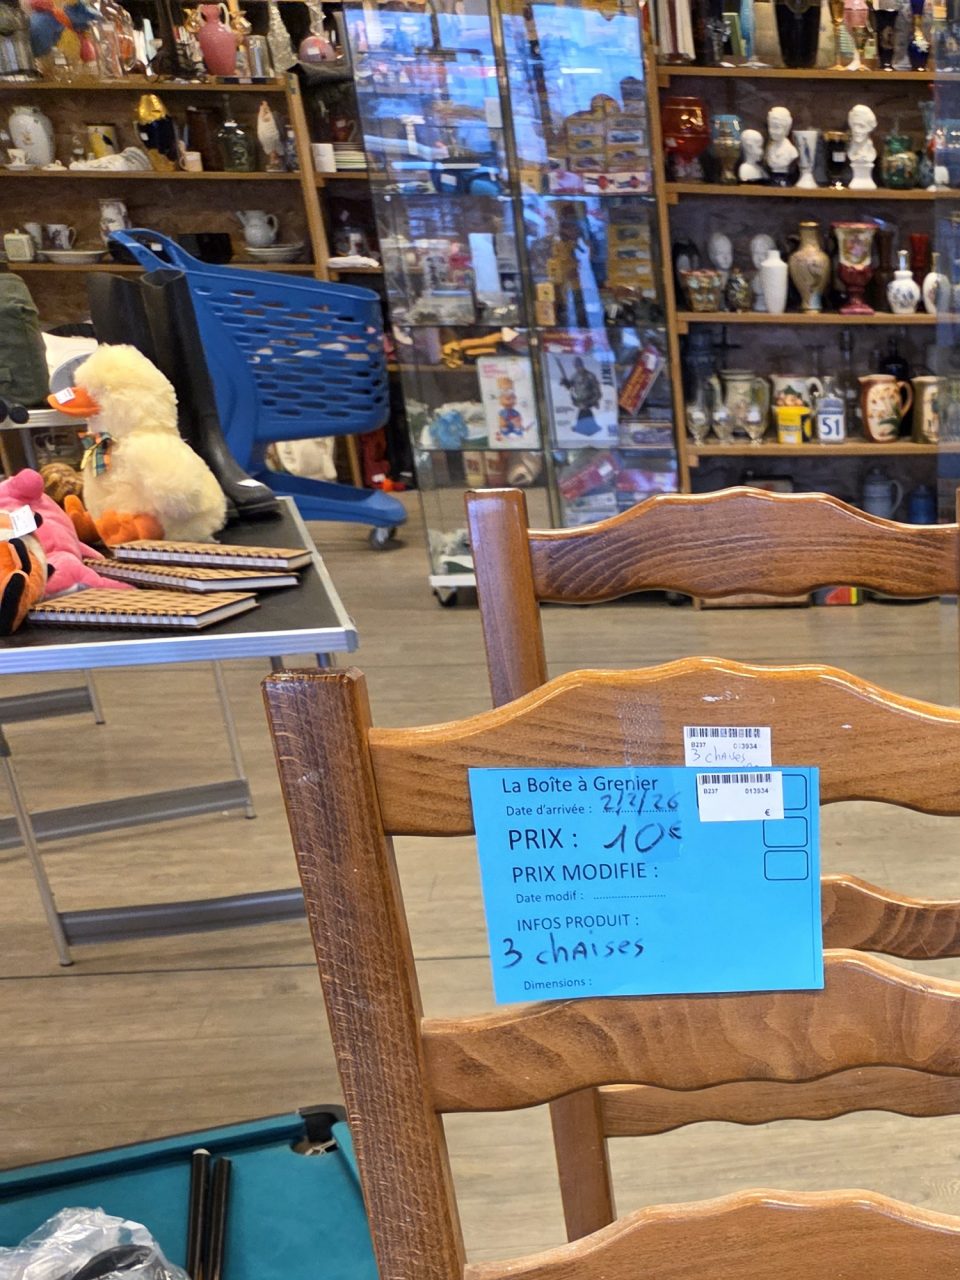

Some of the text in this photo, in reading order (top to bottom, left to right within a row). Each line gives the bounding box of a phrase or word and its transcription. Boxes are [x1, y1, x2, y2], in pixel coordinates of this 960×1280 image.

[820, 417, 841, 436] 51
[502, 775, 659, 793] La Boîte à Grenier
[506, 805, 533, 816] Date
[508, 828, 564, 850] PRIX
[512, 865, 557, 883] PRIX
[562, 862, 647, 881] MODIFIE
[516, 893, 542, 904] Date
[545, 890, 577, 902] modif
[517, 917, 561, 932] INFOS
[565, 913, 630, 928] PRODUIT
[502, 938, 523, 969] 3
[524, 978, 586, 990] Dimensions
